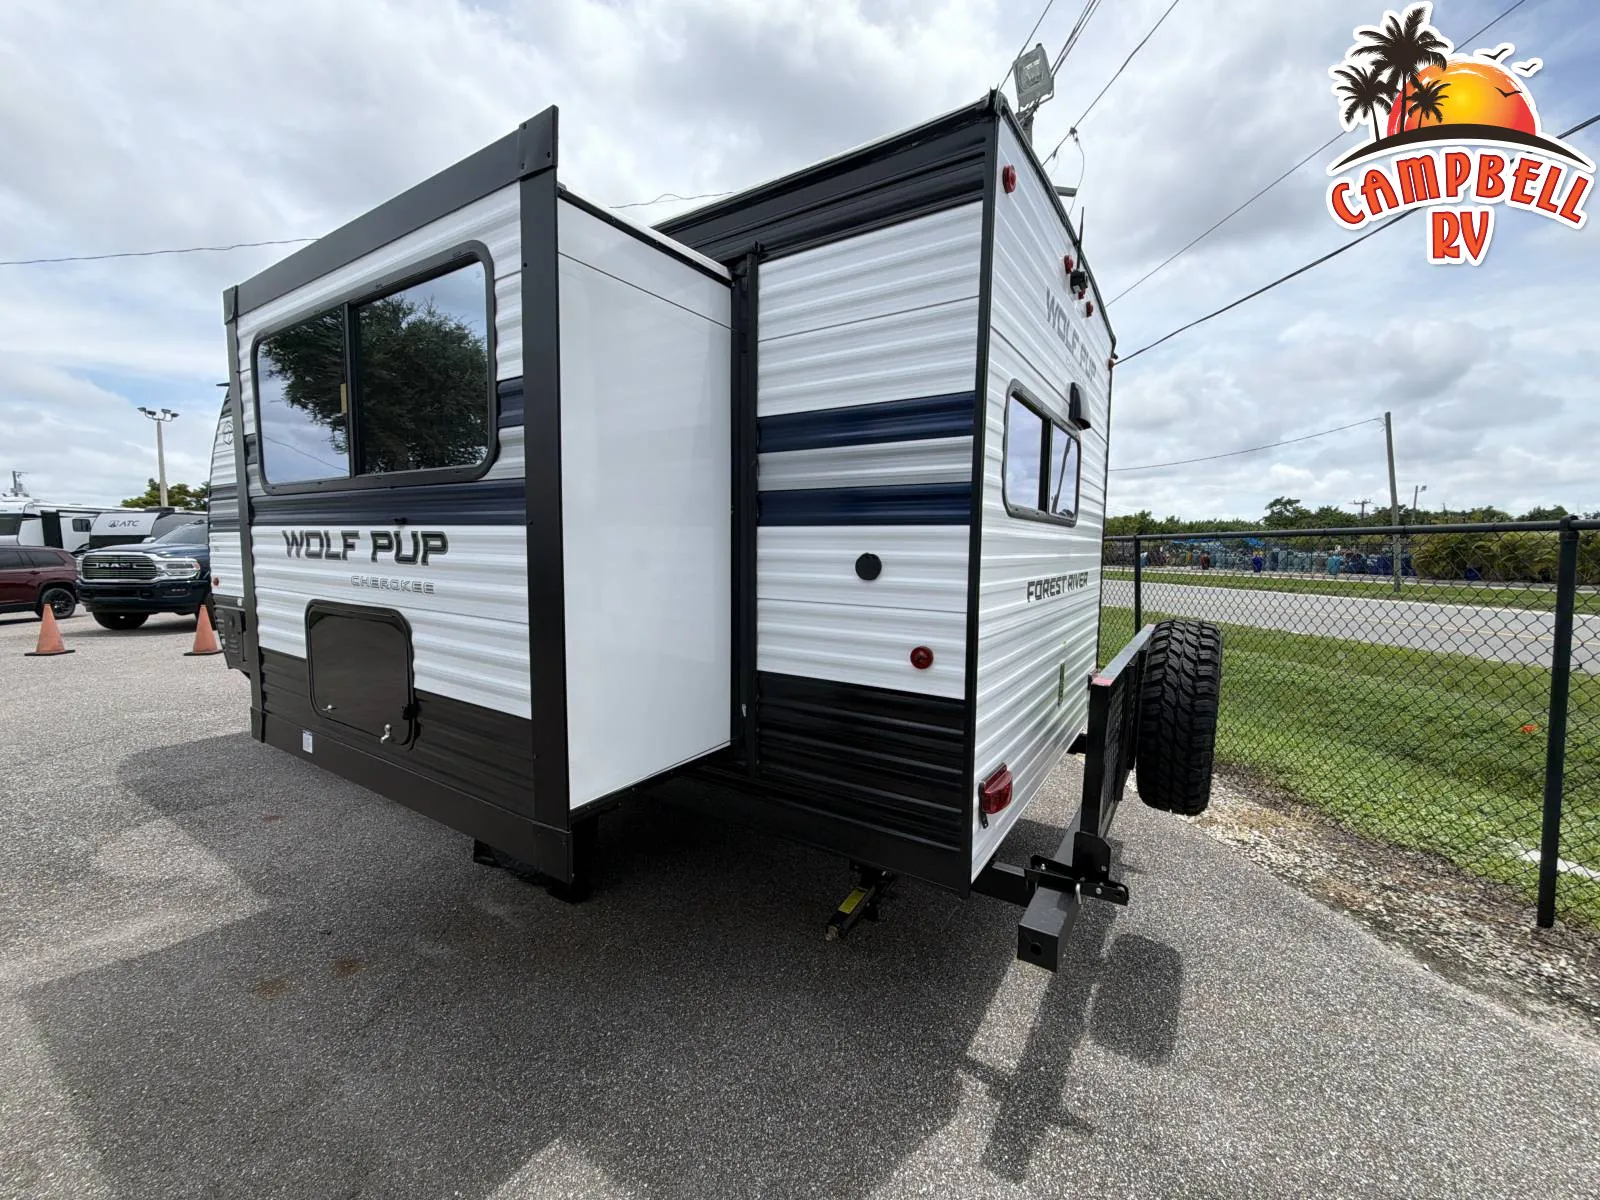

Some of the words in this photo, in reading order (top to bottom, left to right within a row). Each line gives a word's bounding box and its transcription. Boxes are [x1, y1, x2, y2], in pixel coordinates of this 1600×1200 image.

[1046, 287, 1080, 357] WOLF
[281, 529, 361, 561] WOLF
[369, 530, 449, 567] PUP
[350, 575, 436, 595] CHEROKEE
[1026, 576, 1067, 603] FOREST
[1067, 571, 1089, 592] RIVER
